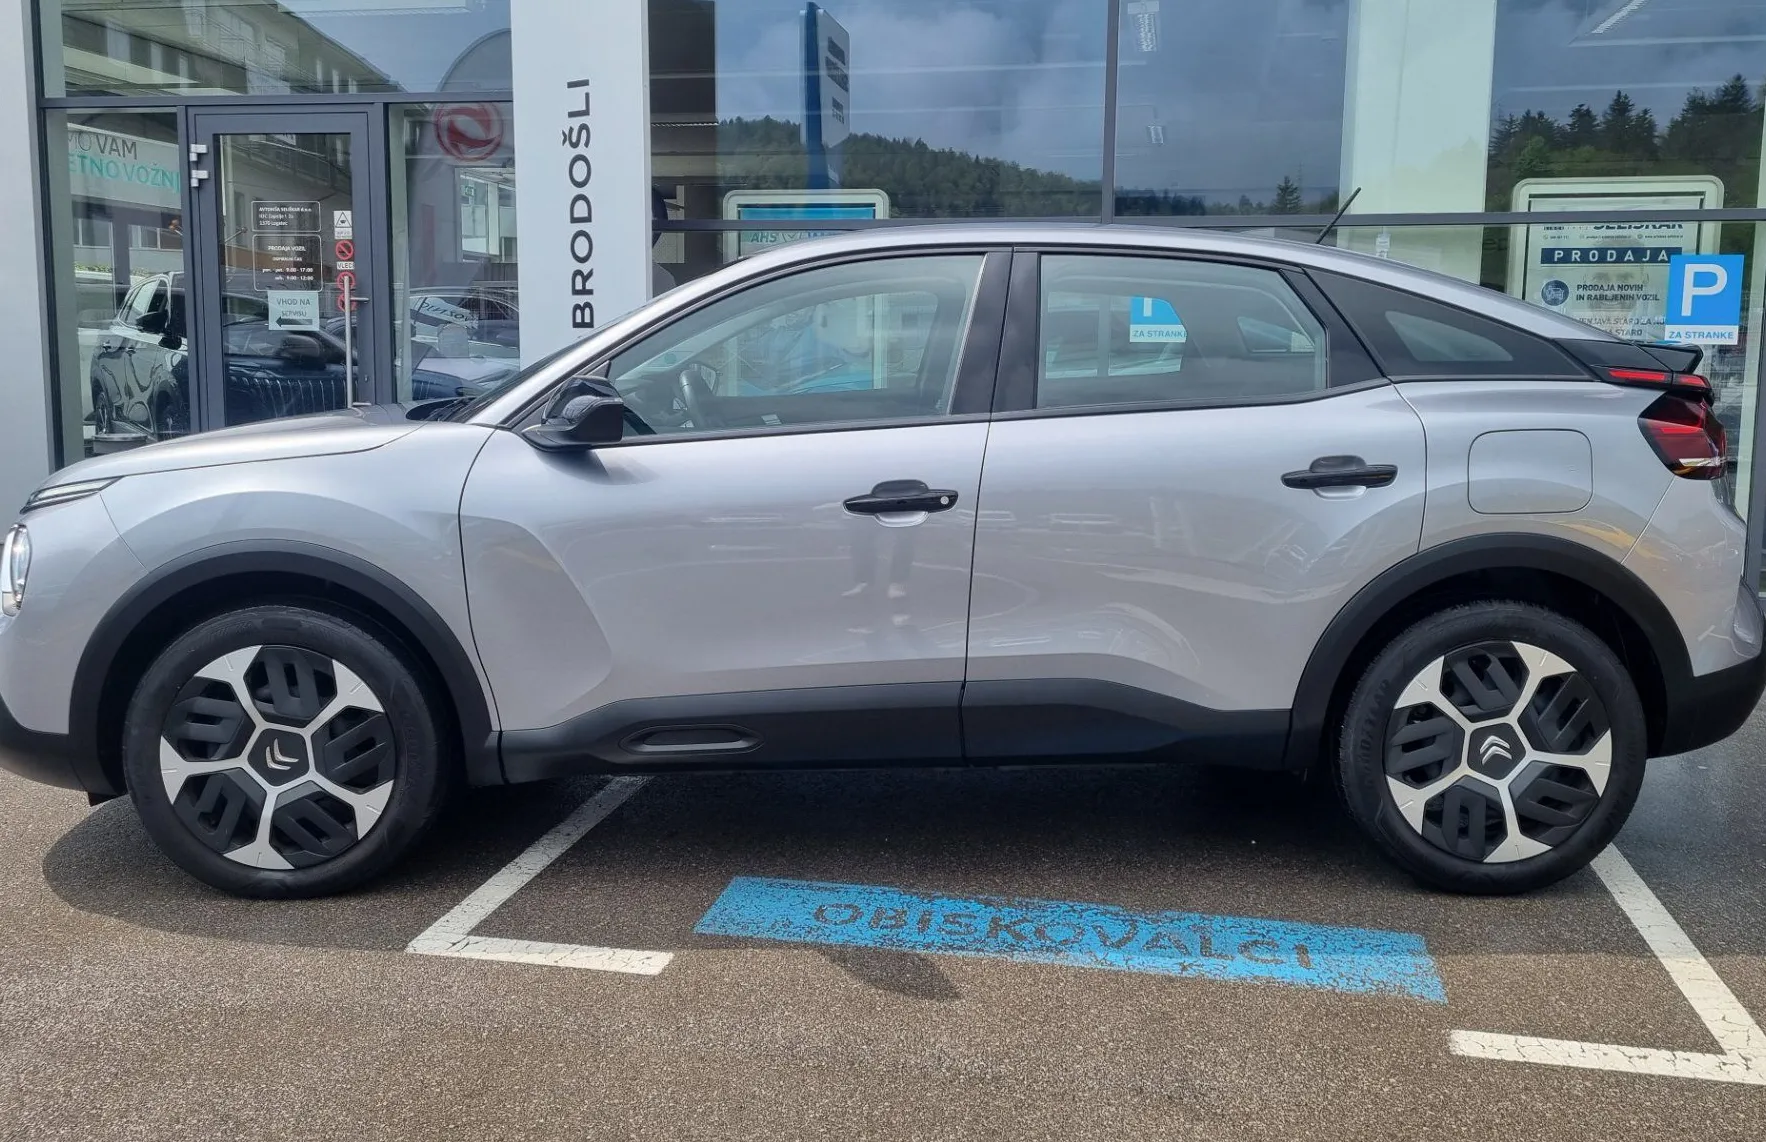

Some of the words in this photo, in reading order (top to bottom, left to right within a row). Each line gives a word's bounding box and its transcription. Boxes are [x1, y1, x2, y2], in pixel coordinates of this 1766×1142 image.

[96, 135, 138, 160] VAM
[561, 78, 595, 329] BRODOŠLI
[1554, 250, 1669, 262] PRODAJA
[1576, 284, 1615, 292] PRODAJA
[1681, 263, 1728, 317] P
[276, 298, 298, 306] VHOD
[299, 298, 311, 306] NA
[1132, 330, 1145, 338] ZA
[1668, 331, 1682, 339] ZA
[1684, 331, 1735, 339] STRANKE
[813, 902, 1313, 969] OBISKOVALCI
